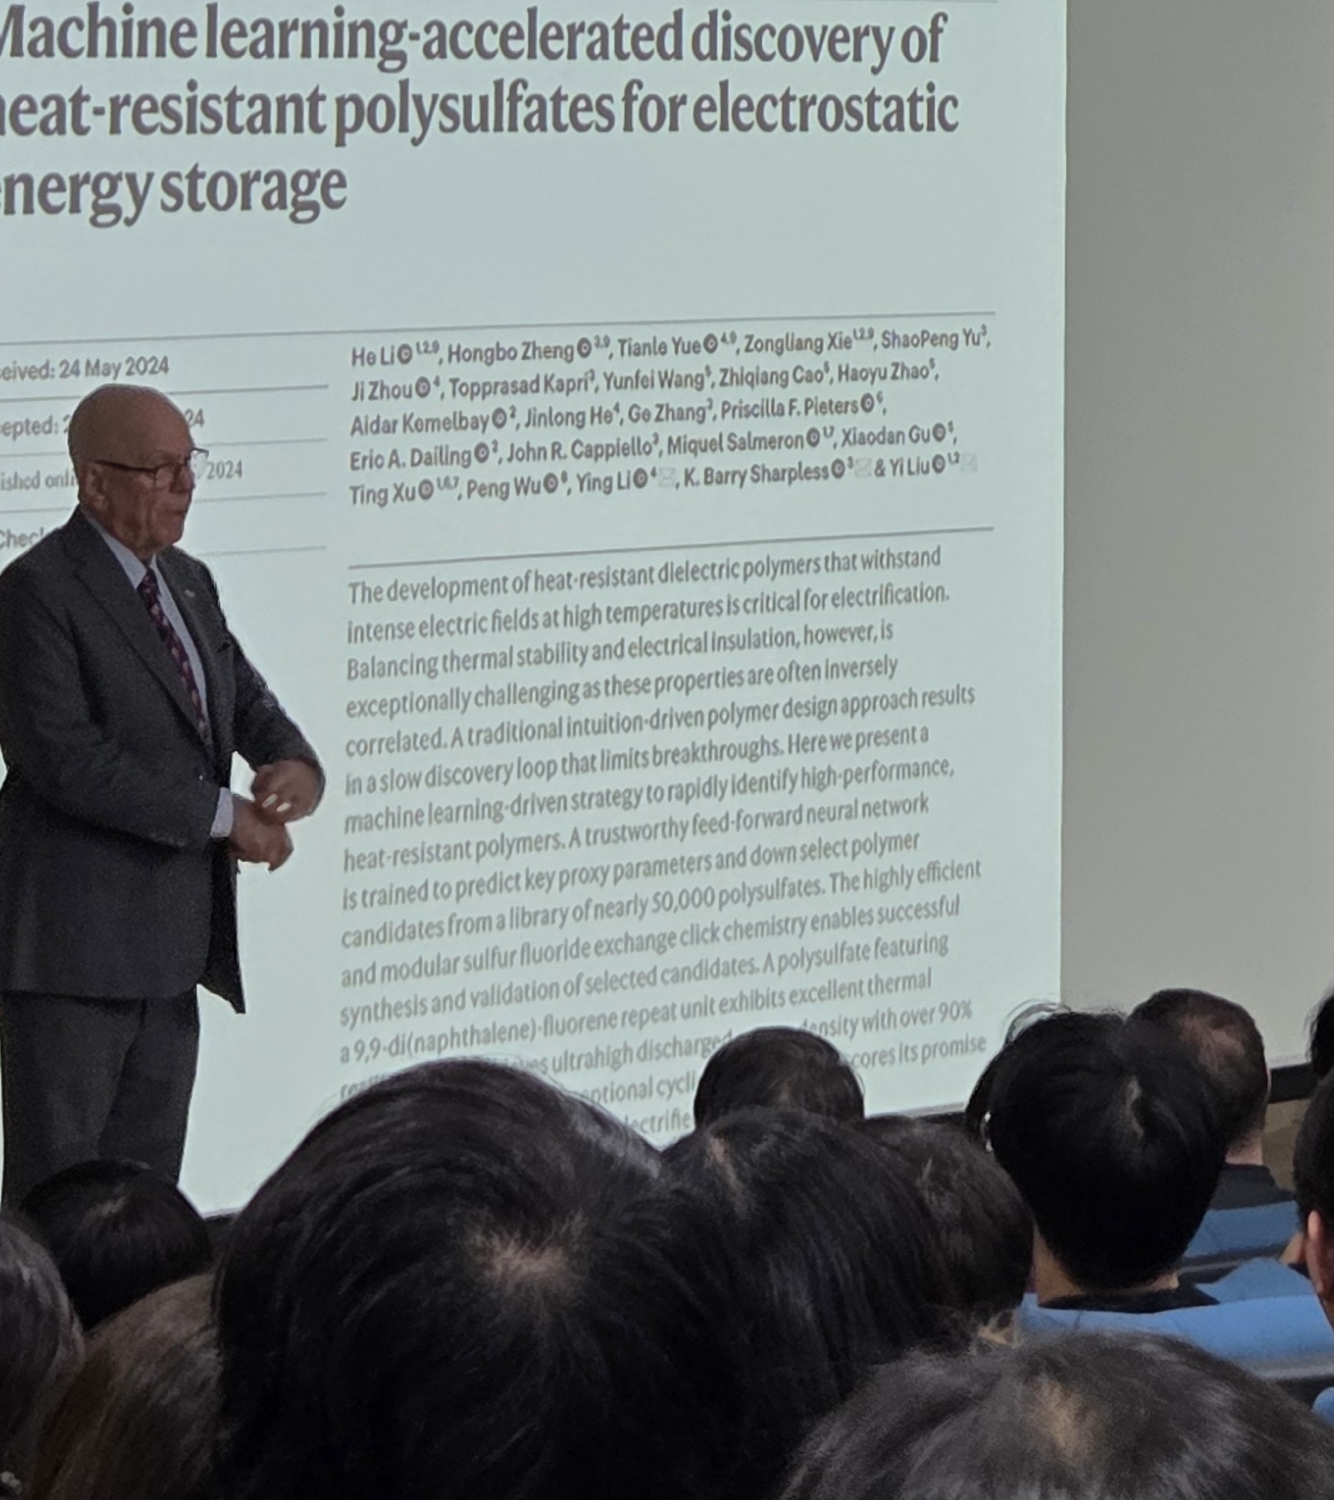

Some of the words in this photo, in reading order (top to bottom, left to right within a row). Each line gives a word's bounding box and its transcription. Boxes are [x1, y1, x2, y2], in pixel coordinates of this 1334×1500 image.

[206, 1, 684, 74] learning-accelerated
[691, 8, 896, 75] discovery
[900, 11, 949, 63] of
[334, 77, 615, 148] polysulfates
[622, 78, 687, 132] for
[692, 78, 959, 133] electrostatic
[160, 162, 348, 224] storage
[58, 359, 81, 379] 24
[85, 358, 122, 381] May
[125, 355, 169, 377] 2024
[387, 576, 508, 604] development
[534, 565, 654, 592] heat-resistant
[658, 557, 740, 584] dielectric
[743, 554, 821, 584] polymers
[861, 545, 941, 570] withstand
[348, 621, 415, 644] intense
[419, 612, 487, 638] electric
[492, 607, 539, 633] fields
[606, 599, 723, 627] temperatures
[743, 588, 800, 615] critical
[831, 581, 949, 609] electrification.
[347, 653, 438, 681] Balancing
[442, 644, 513, 673] thermal
[517, 641, 589, 668] stability
[628, 631, 708, 659] electrical
[711, 626, 800, 652] insulation,
[804, 624, 877, 646] however,
[346, 687, 471, 721] exceptionally
[474, 680, 580, 708] challenging
[654, 667, 744, 699] properties
[825, 654, 897, 680] inversely
[346, 726, 447, 758] correlated.
[468, 716, 563, 747] traditional
[567, 707, 704, 738] intuition-driven
[708, 701, 779, 731] polymer
[782, 695, 837, 722] design
[841, 687, 918, 719] approach
[922, 683, 975, 708] results
[425, 763, 513, 788] discovery
[600, 747, 649, 772] limits
[652, 735, 784, 767] breakthroughs.
[855, 726, 917, 754] present
[345, 806, 424, 834] machine
[428, 792, 567, 826] learning-driven
[571, 787, 643, 811] strategy
[668, 774, 728, 805] rapidly
[731, 767, 798, 796] identify
[801, 759, 953, 793] high-performance,
[344, 840, 471, 873] heat-resistant
[476, 832, 565, 864] polymers.
[585, 816, 689, 847] trustworthy
[692, 803, 803, 836] feed-forward
[806, 798, 858, 824] neural
[862, 791, 928, 819] network
[342, 919, 444, 949] candidates
[510, 906, 569, 930] library
[594, 893, 648, 921] nearly
[652, 886, 715, 913] 50,000
[718, 877, 825, 912] polysulfates.
[863, 864, 914, 893] highly
[917, 860, 980, 884] efficient
[361, 879, 428, 908] trained
[456, 871, 521, 904] predict
[613, 854, 712, 886] parameters
[800, 837, 848, 862] select
[851, 832, 919, 862] polymer
[381, 952, 460, 984] modular
[520, 937, 590, 966] fluoride
[594, 931, 677, 957] exchange
[723, 915, 807, 942] chemistry
[811, 906, 874, 932] enables
[878, 894, 960, 925] successful
[341, 995, 427, 1030] synthesis
[470, 980, 560, 1008] validation
[585, 965, 657, 995] selected
[661, 957, 759, 985] candidates.
[778, 940, 870, 977] polysulfate
[874, 933, 948, 960] featuring
[719, 987, 785, 1014] exhibits
[789, 979, 864, 1006] excellent
[868, 967, 931, 996] thermal
[921, 1033, 986, 1063] promise
